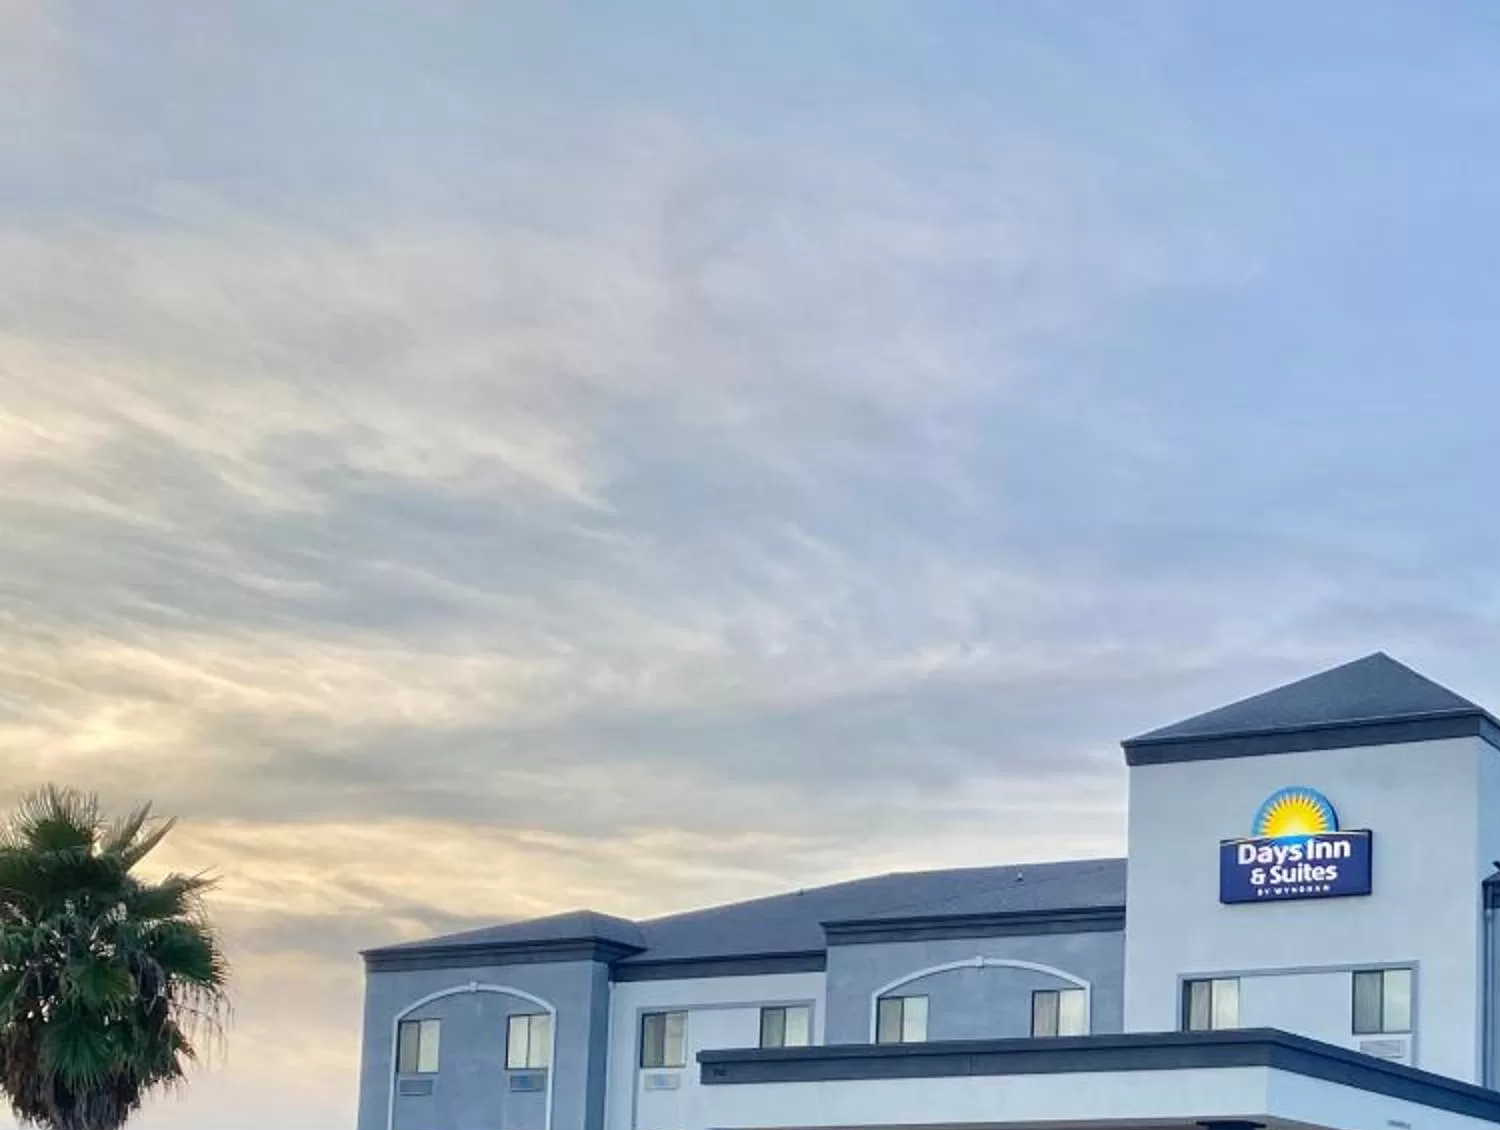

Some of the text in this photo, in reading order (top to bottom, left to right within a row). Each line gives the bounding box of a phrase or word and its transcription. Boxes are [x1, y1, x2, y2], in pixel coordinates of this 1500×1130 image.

[1238, 838, 1351, 865] Days Inn
[1250, 862, 1338, 885] & Suites
